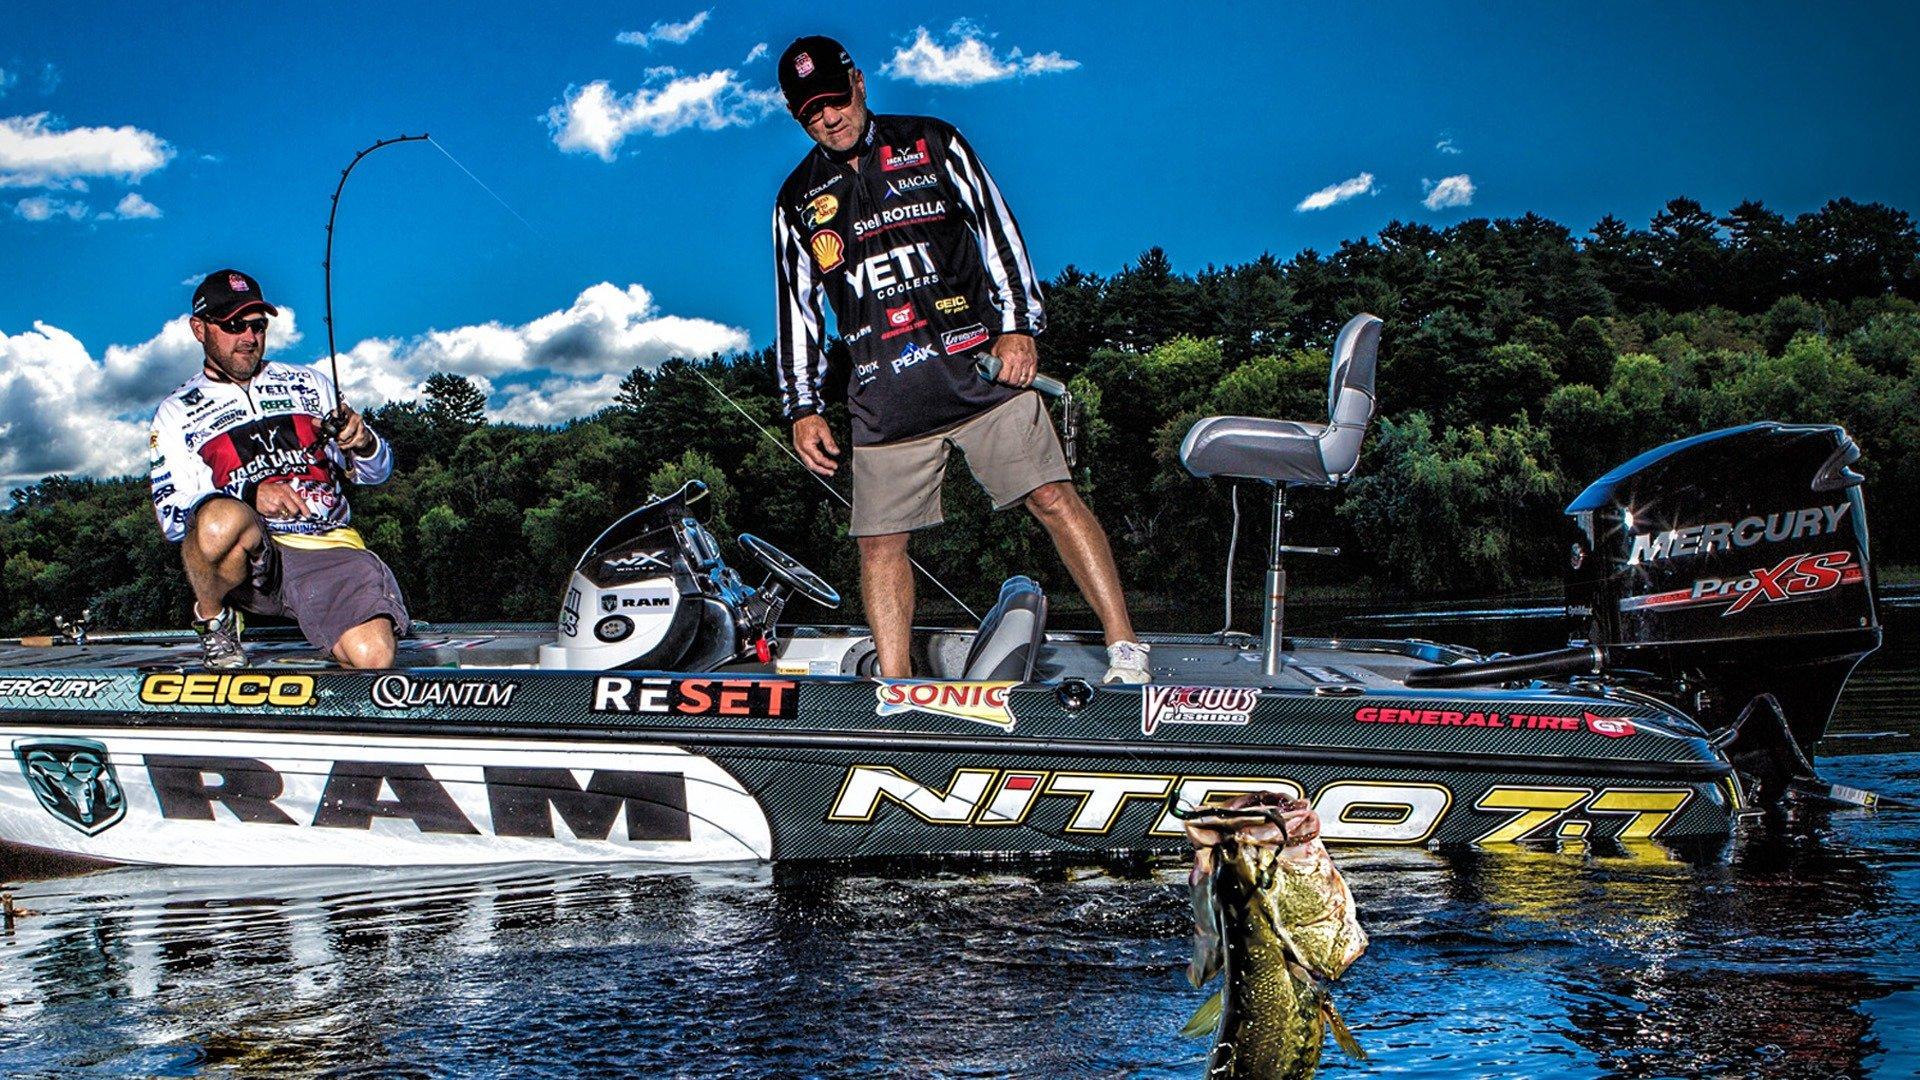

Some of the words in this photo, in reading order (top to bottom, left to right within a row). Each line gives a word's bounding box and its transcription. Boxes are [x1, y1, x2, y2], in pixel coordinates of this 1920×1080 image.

[898, 173, 938, 190] BACAS
[881, 200, 946, 224] ROTELLA
[845, 242, 936, 299] YETI
[877, 274, 940, 300] COOLERS
[935, 295, 966, 310] GEIC
[891, 342, 939, 374] PEAK
[260, 399, 296, 411] REPEL
[229, 454, 270, 483] JACK
[1627, 501, 1851, 566] MERCURY
[622, 598, 670, 608] RAM
[141, 674, 315, 706] GEICO
[372, 675, 516, 709] QUANTUM
[594, 678, 796, 716] RESET
[885, 682, 1008, 709] SONIC
[1163, 712, 1247, 722] FISHING
[1355, 707, 1504, 728] GENERAL
[1508, 713, 1581, 731] TIRE
[1592, 717, 1630, 733] GT
[144, 754, 692, 842] RAM
